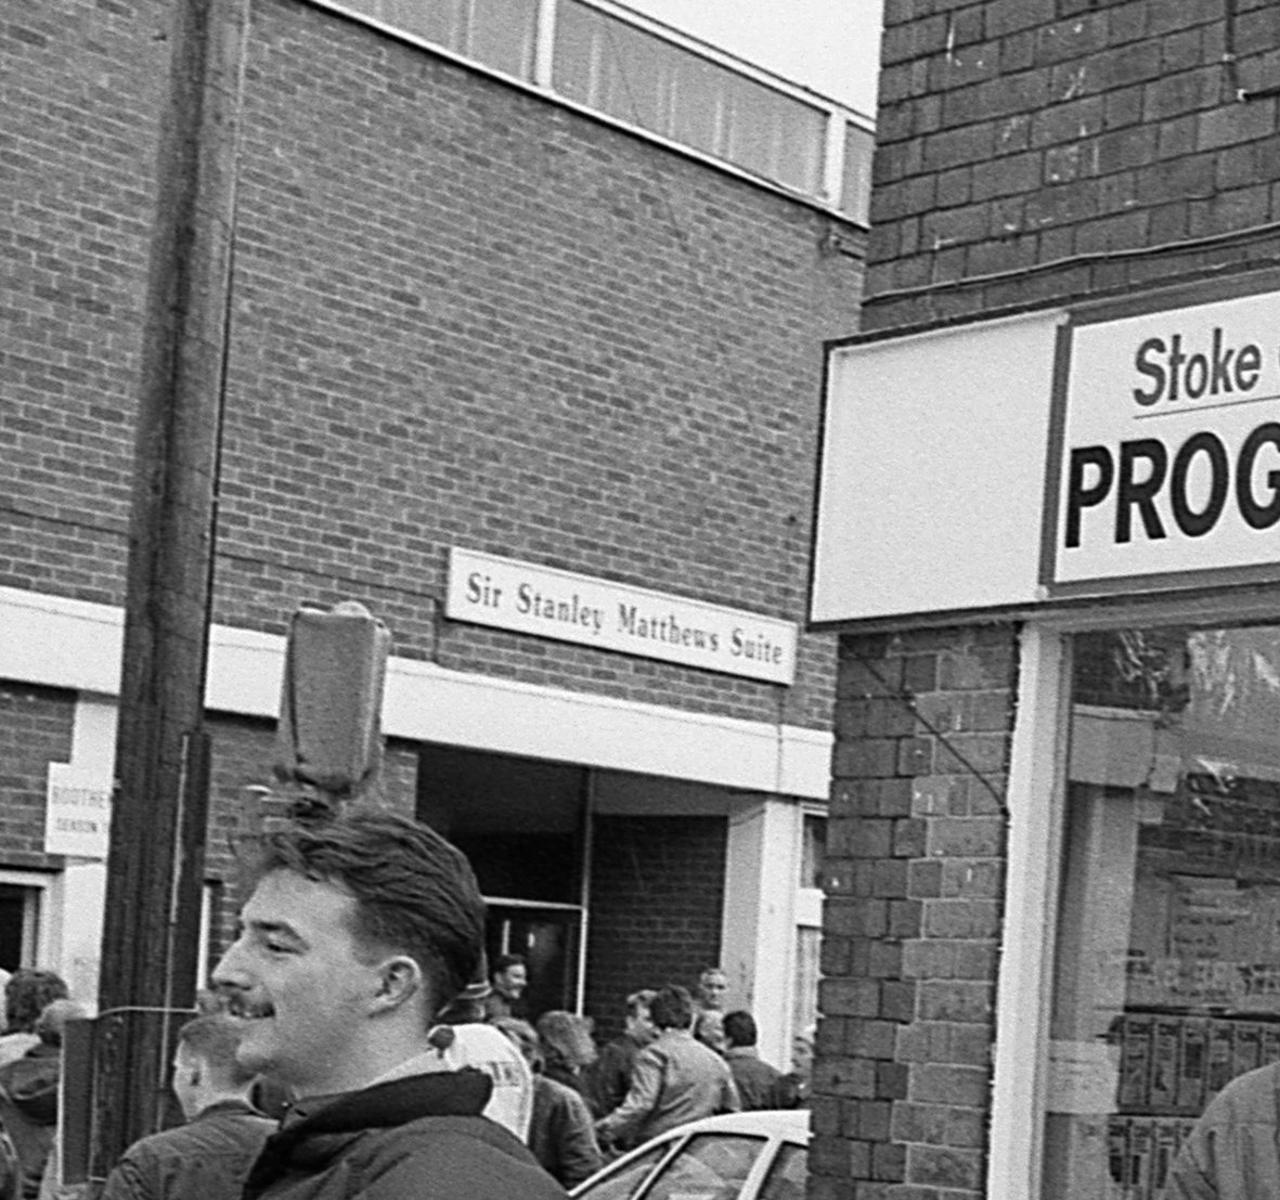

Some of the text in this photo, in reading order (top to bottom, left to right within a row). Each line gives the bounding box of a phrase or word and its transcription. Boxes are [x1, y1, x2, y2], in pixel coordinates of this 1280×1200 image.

[1133, 328, 1262, 407] Stoke
[466, 571, 783, 665] Sir Stanley Matthews Suite
